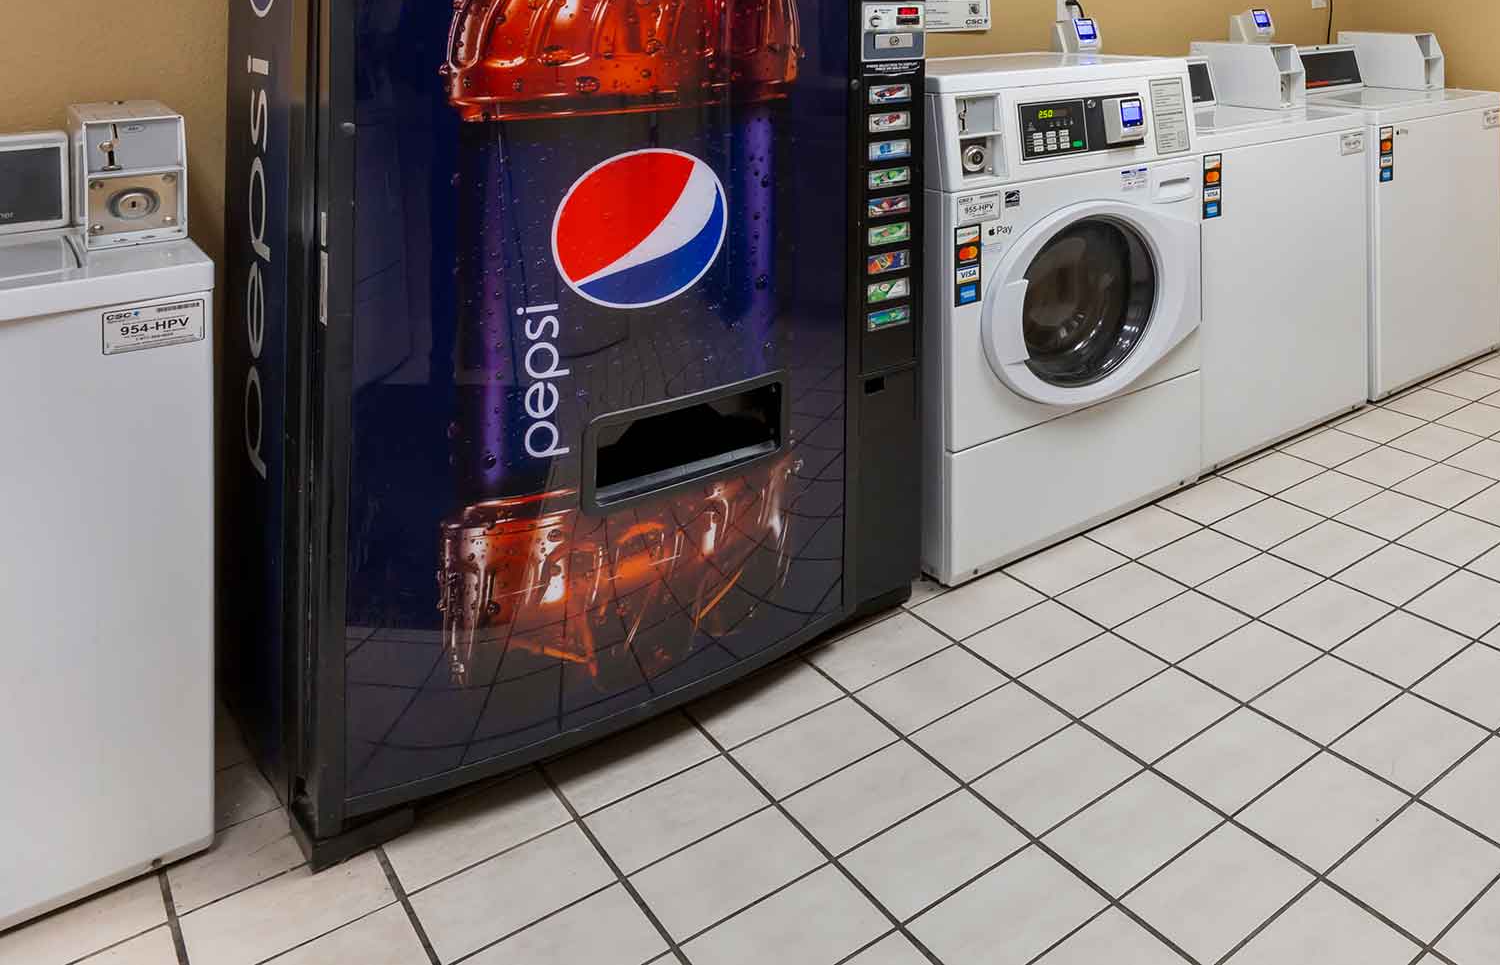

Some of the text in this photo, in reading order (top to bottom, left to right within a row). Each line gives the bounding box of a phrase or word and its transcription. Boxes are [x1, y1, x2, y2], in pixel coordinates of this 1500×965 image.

[996, 225, 1013, 235] Pay
[244, 54, 271, 480] pepsi
[960, 269, 977, 278] VISA
[106, 312, 132, 321] CSC
[120, 316, 189, 336] 954-HPV
[516, 303, 570, 458] pepsi
